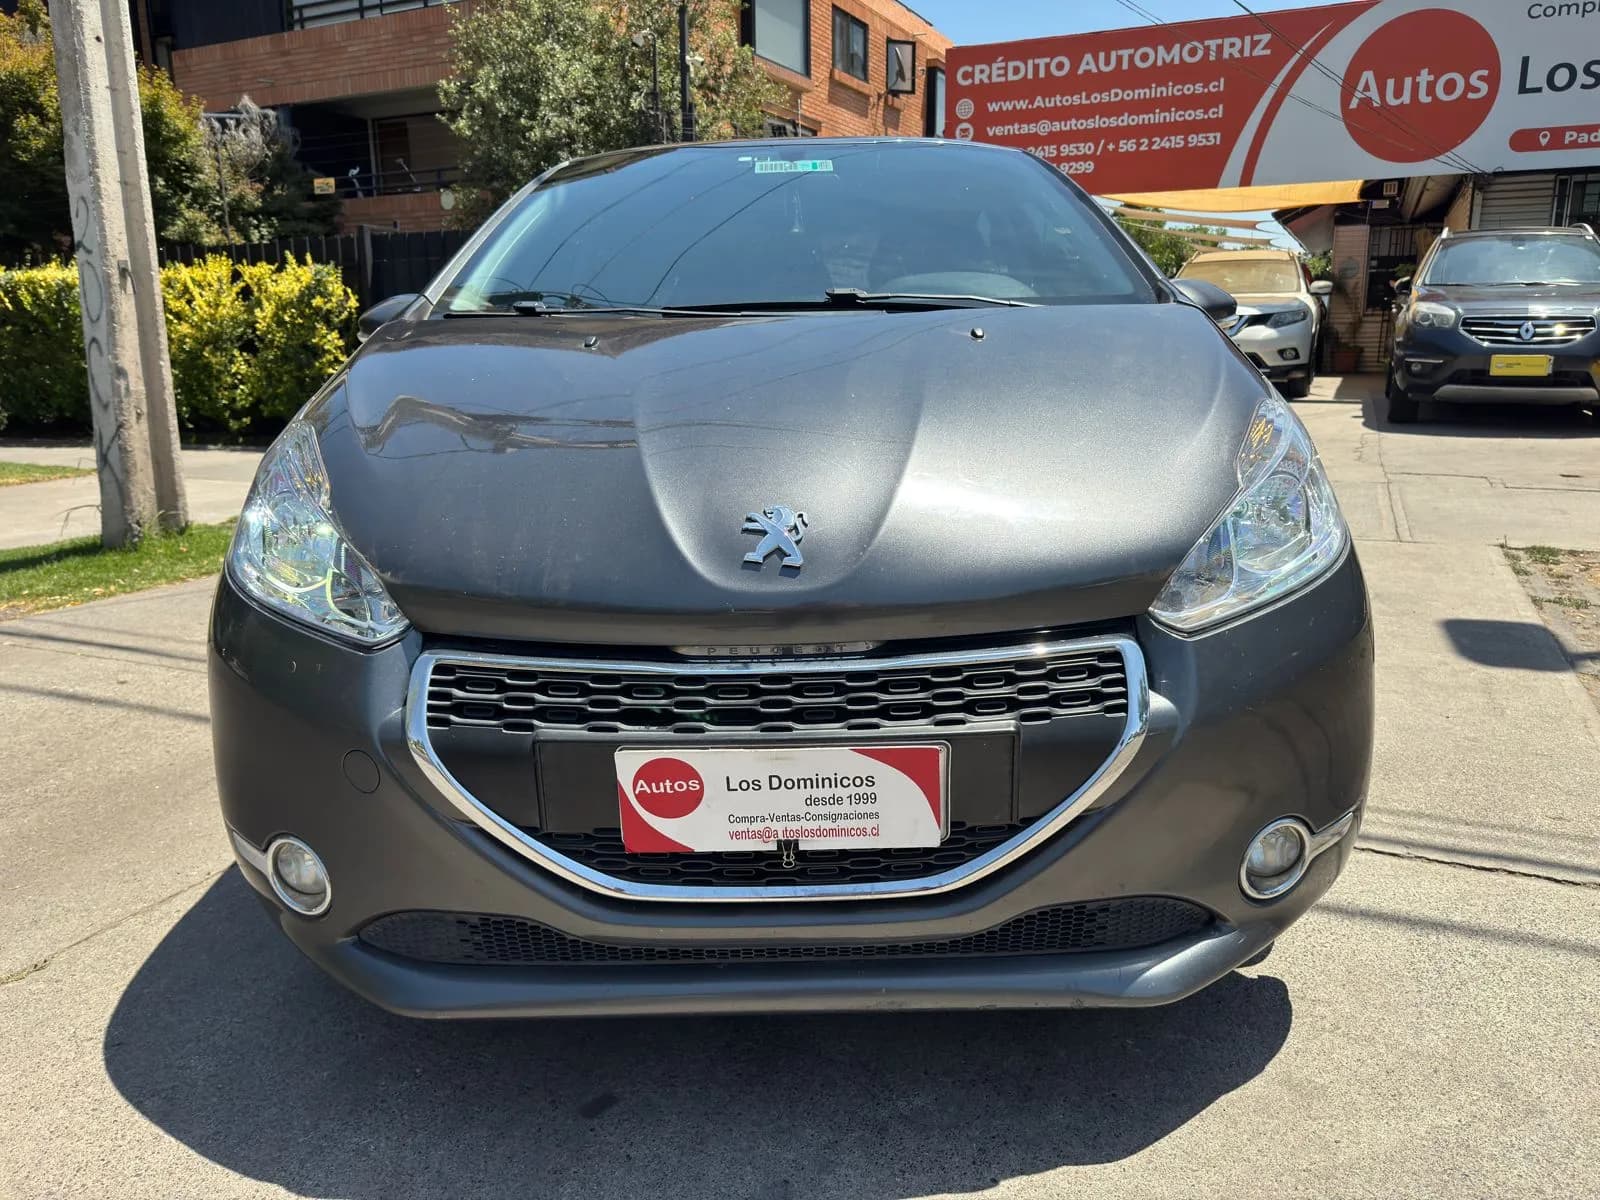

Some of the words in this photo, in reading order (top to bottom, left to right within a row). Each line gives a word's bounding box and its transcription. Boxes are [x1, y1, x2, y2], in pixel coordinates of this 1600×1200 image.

[1527, 0, 1600, 19] Comp
[956, 56, 1071, 87] CRÉDITO
[1077, 33, 1272, 75] AUTOMOTRIZ
[1517, 56, 1600, 95] Los
[987, 78, 1225, 113] www.AutosLosDominicos.cl
[1348, 68, 1489, 109] Autos
[987, 104, 1224, 137] ventas@autoslosdominicos.cl
[1060, 142, 1095, 157] 9530
[1118, 139, 1138, 153] 56
[1140, 138, 1149, 151] 2
[1152, 135, 1184, 151] 2415
[1187, 132, 1221, 148] 9531
[1060, 161, 1095, 175] 9299
[634, 777, 701, 795] Autos
[726, 775, 762, 792] Los
[768, 773, 876, 791] Dominicos
[804, 793, 844, 807] desde
[847, 792, 878, 806] 1999
[728, 810, 880, 825] Compra-Ventas-Consignaciones
